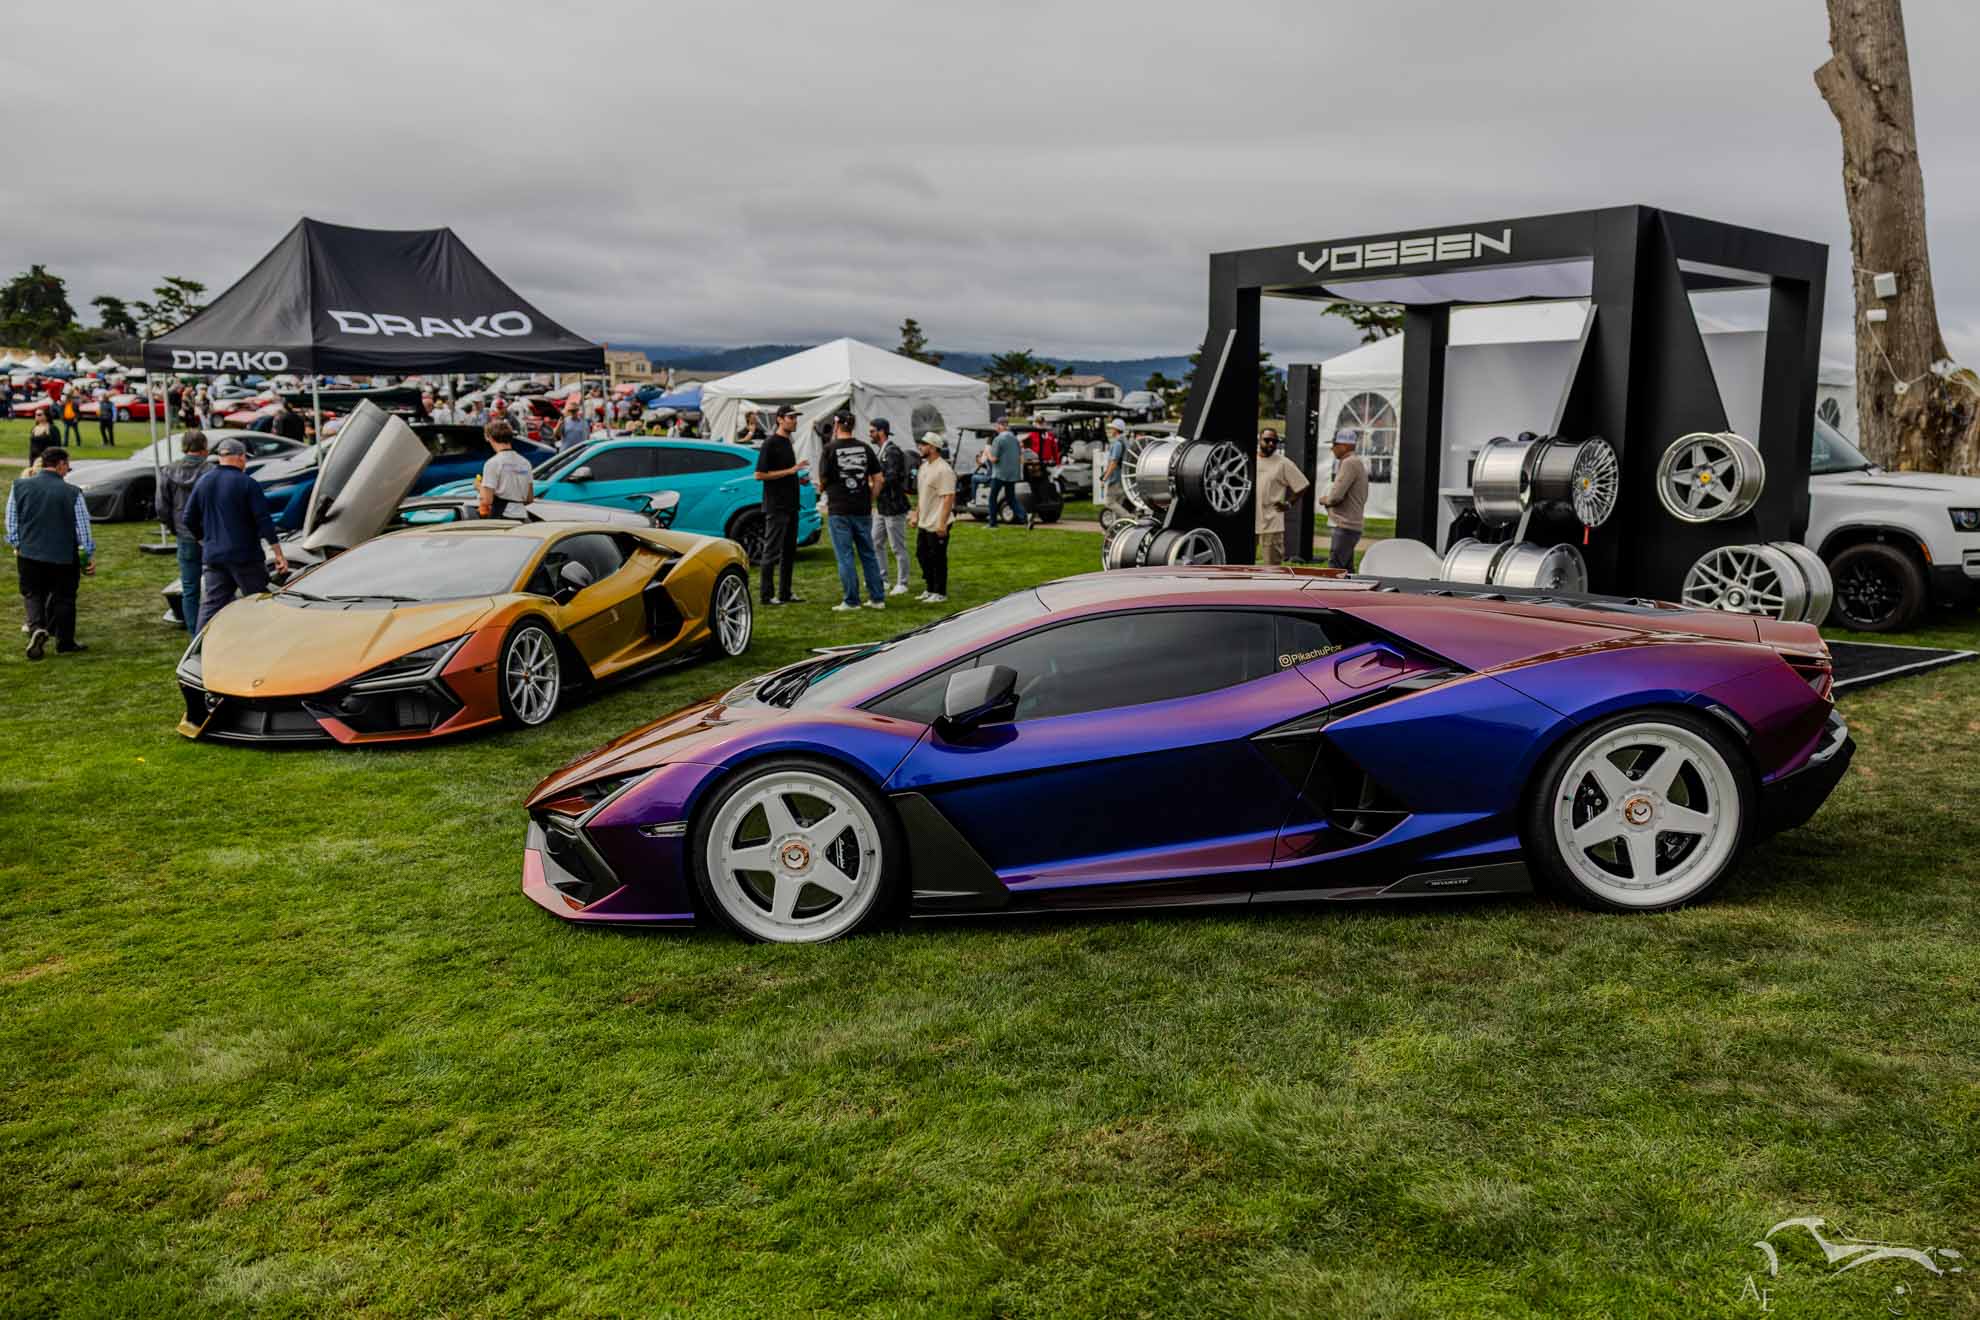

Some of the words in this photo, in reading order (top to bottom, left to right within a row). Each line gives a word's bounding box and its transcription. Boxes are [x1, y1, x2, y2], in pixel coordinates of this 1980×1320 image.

[1297, 228, 1512, 273] VOSSEN
[327, 310, 534, 338] DRAKO
[171, 349, 289, 371] DRAKO
